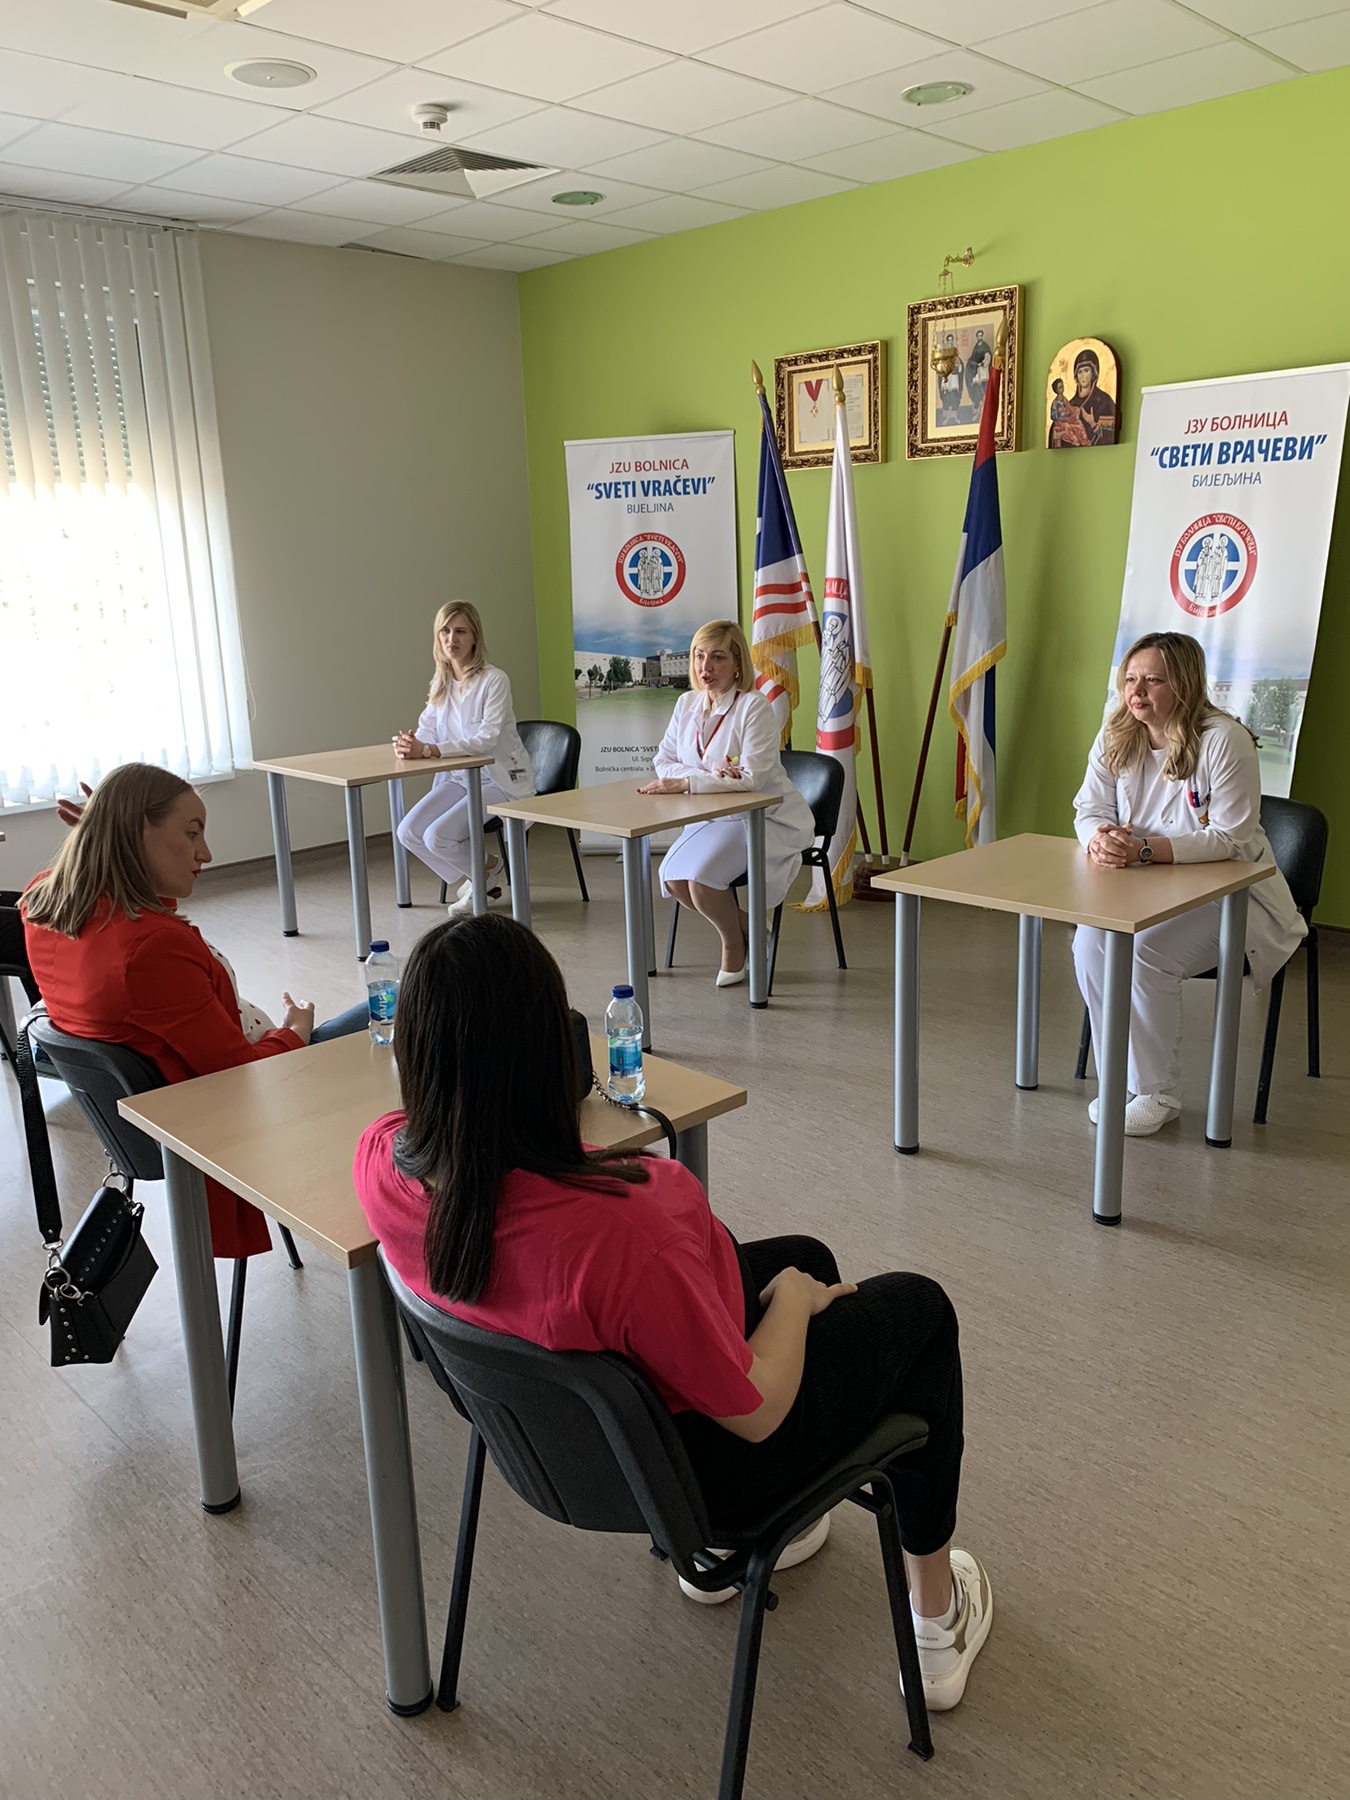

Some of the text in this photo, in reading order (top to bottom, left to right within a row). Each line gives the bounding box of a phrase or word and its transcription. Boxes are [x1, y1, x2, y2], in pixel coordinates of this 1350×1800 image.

[1184, 411, 1288, 434] ЈЗУ БОЛНИЦА
[609, 459, 689, 474] JZU BOLNICA
[1192, 471, 1262, 488] БИЈЕЉИНА
[627, 502, 674, 514] BIJELJINA
